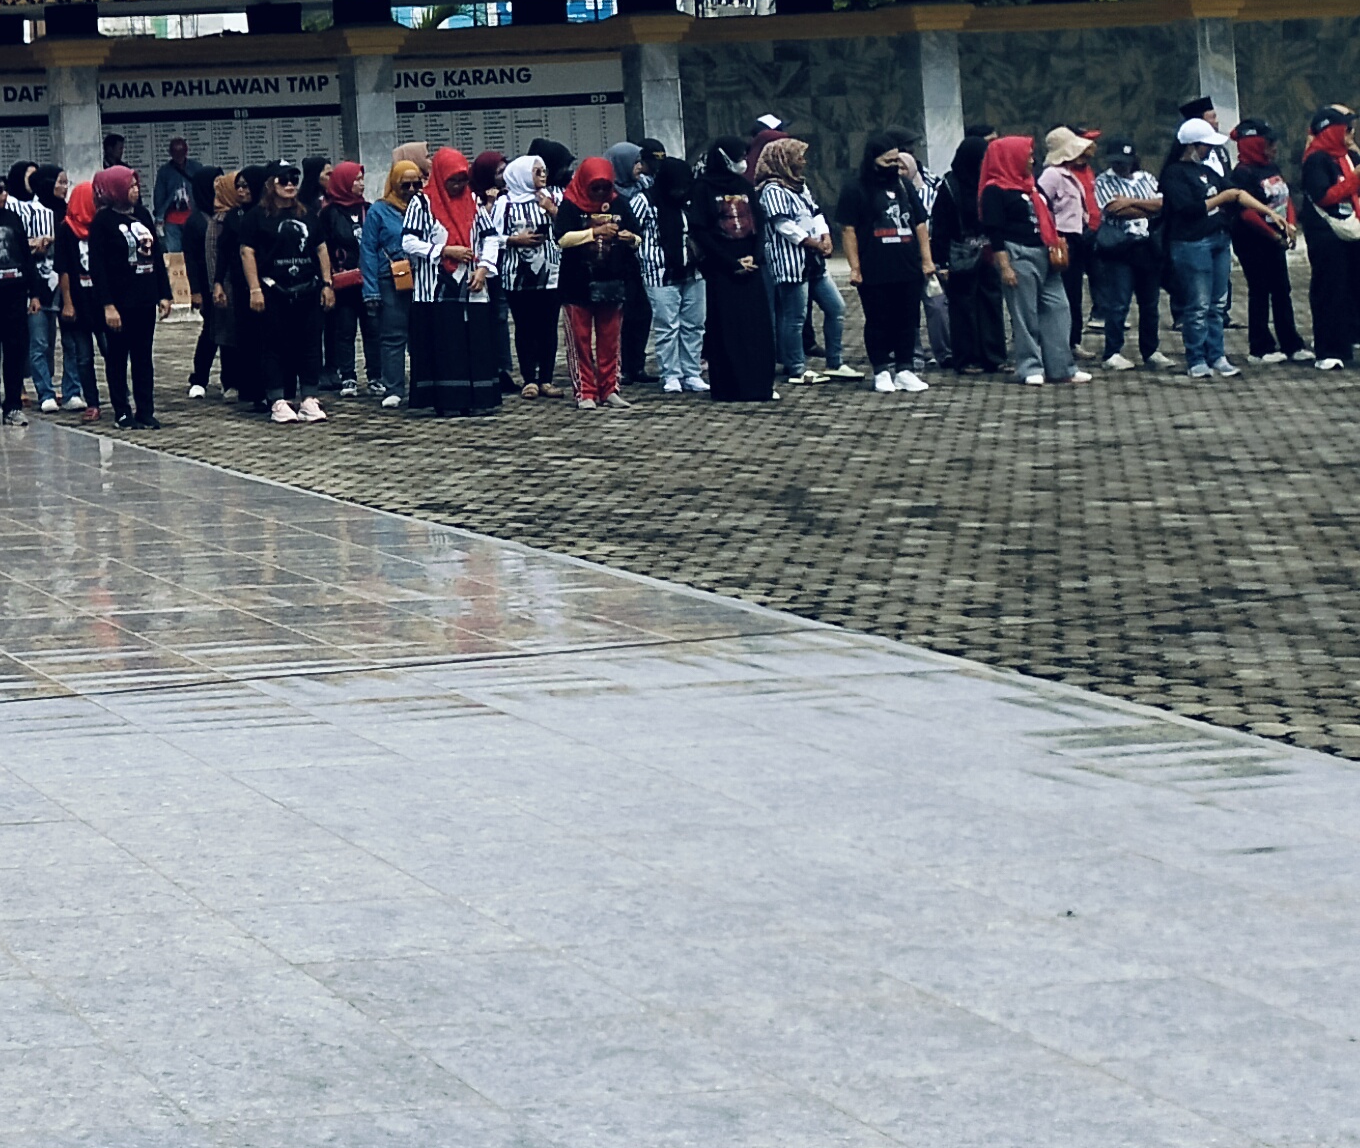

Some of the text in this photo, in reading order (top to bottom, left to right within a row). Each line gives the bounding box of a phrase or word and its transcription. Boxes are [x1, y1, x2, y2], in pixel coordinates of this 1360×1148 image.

[162, 76, 280, 97] PAHLAWAN
[286, 74, 329, 93] TMP
[443, 66, 532, 87] KARANG
[435, 89, 466, 100] BLOK
[417, 102, 426, 111] D
